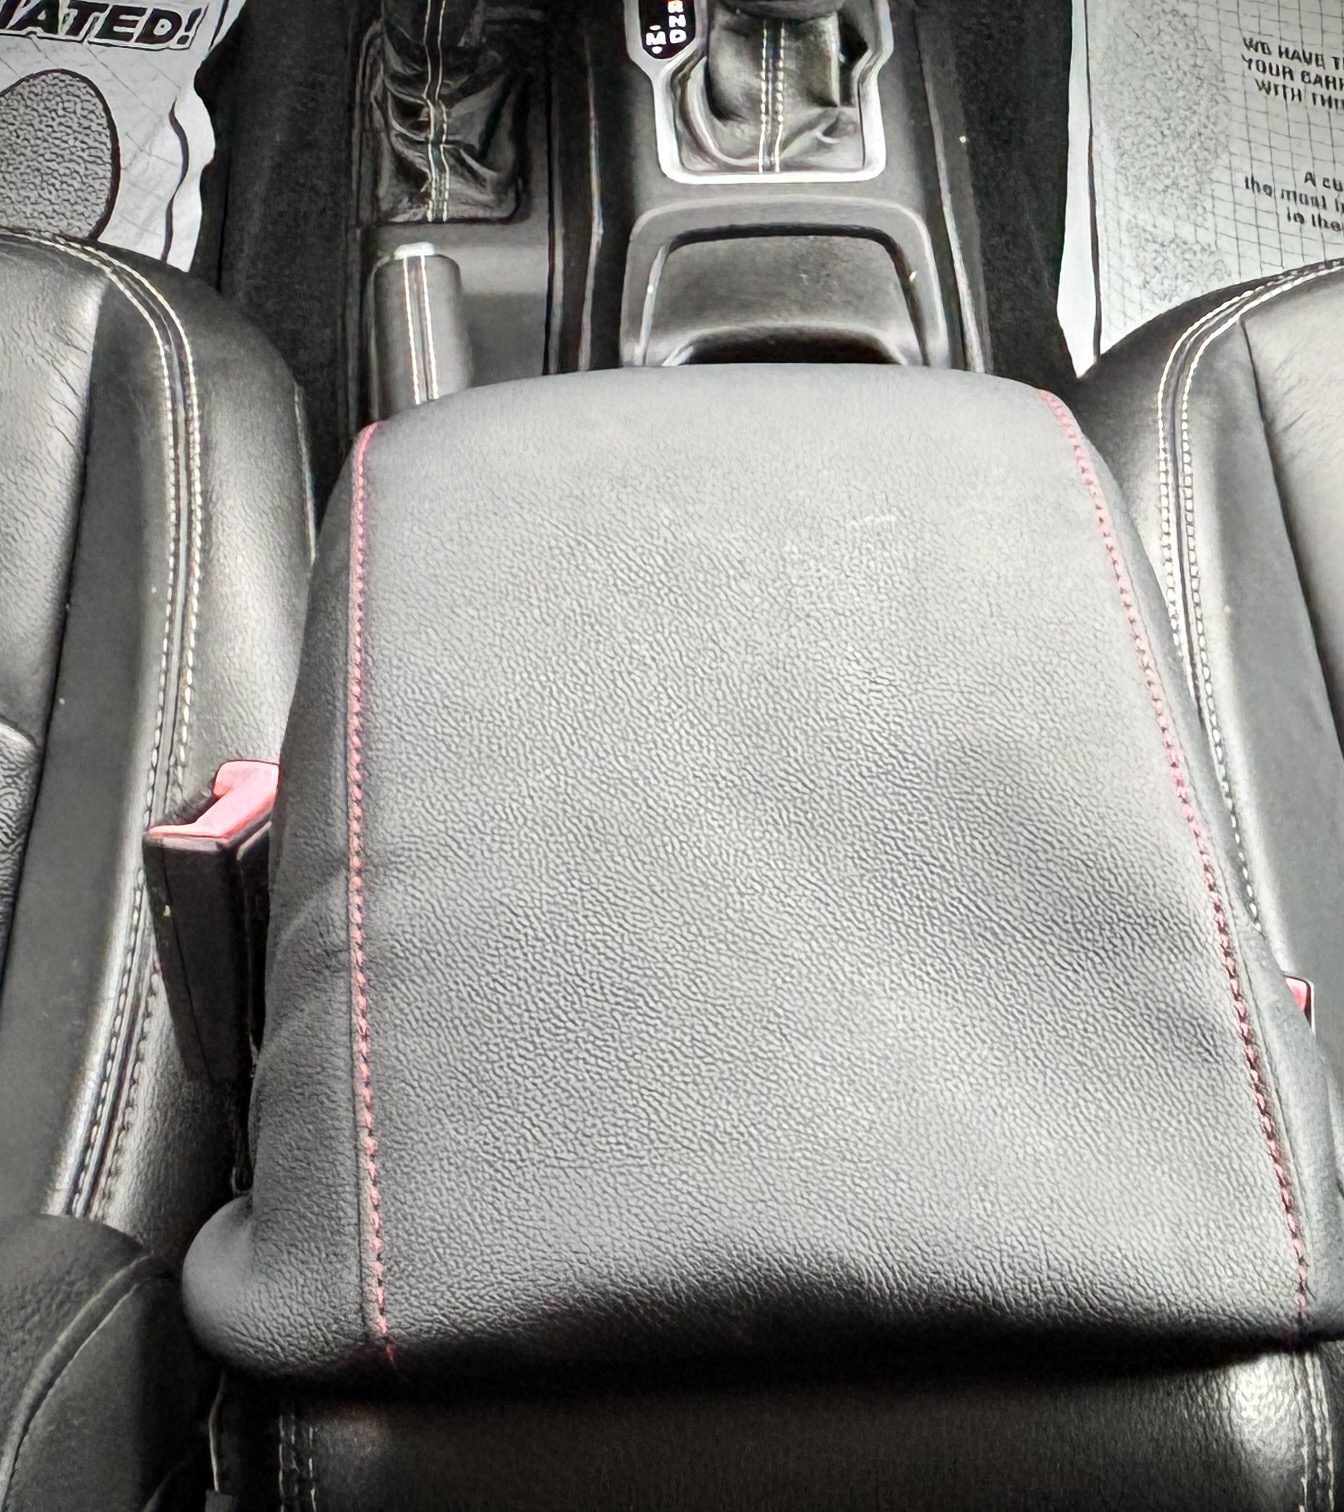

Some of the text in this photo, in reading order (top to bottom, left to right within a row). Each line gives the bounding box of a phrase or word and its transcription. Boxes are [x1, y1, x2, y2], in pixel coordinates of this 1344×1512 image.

[668, 0, 684, 13] R
[669, 14, 686, 27] N
[646, 31, 666, 45] M
[669, 30, 687, 44] D
[1278, 45, 1325, 68] HAVE
[1241, 53, 1295, 82] YOUR
[1254, 78, 1303, 103] WITH
[1304, 172, 1317, 187] A
[1244, 174, 1273, 194] the
[1280, 188, 1328, 211] most
[1312, 211, 1341, 232] the
